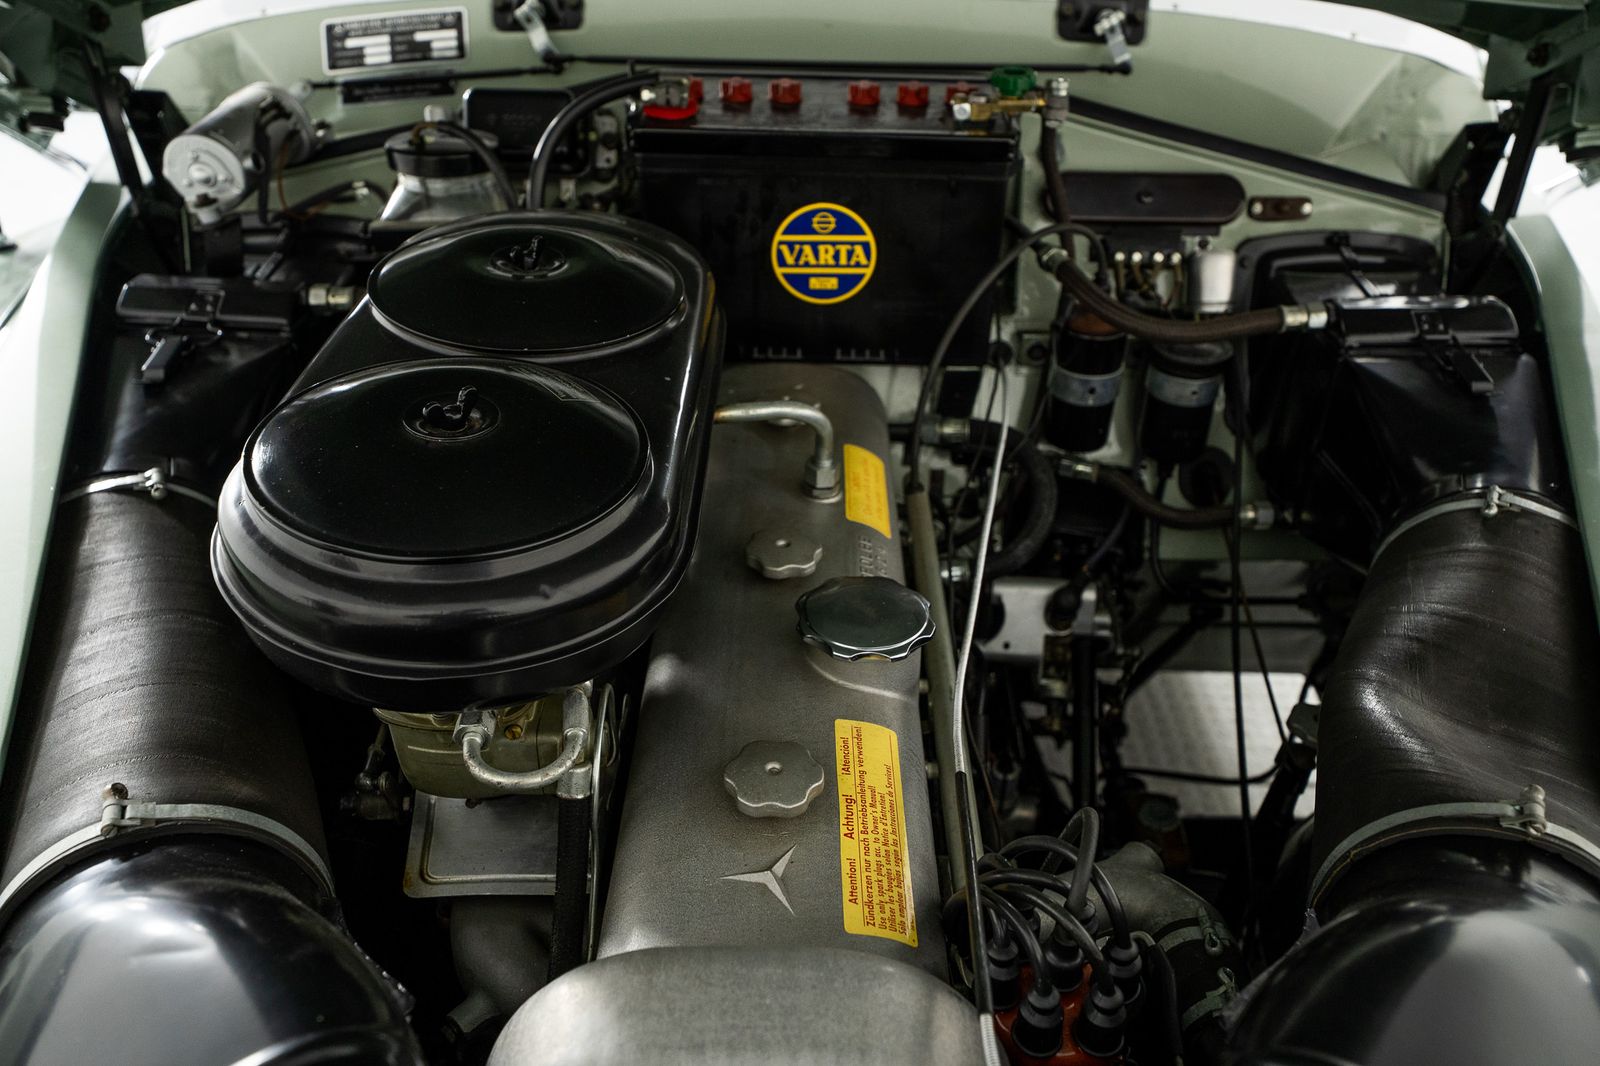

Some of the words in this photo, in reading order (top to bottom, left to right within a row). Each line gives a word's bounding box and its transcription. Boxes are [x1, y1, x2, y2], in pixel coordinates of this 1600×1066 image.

[779, 244, 868, 265] VARTA
[854, 726, 863, 767] verwenden!
[884, 764, 893, 789] Services!
[857, 770, 868, 834] Betriebsanleitung
[868, 785, 877, 809] Manual!
[842, 794, 855, 840] Achtung!
[878, 792, 887, 826] d'Entretien!
[870, 811, 879, 834] Owner's
[861, 838, 870, 856] nach
[881, 828, 889, 847] Notice
[890, 839, 898, 848] las
[874, 860, 885, 876] plugs
[883, 850, 891, 865] selon
[846, 858, 858, 904] Attention!
[875, 879, 885, 897] spark
[884, 868, 895, 892] bougies
[864, 875, 875, 927] Zündkerzen
[876, 901, 886, 914] only
[886, 896, 894, 904] les
[895, 892, 905, 918] emplear
[878, 917, 887, 929] Use
[887, 907, 897, 932] Utiliser
